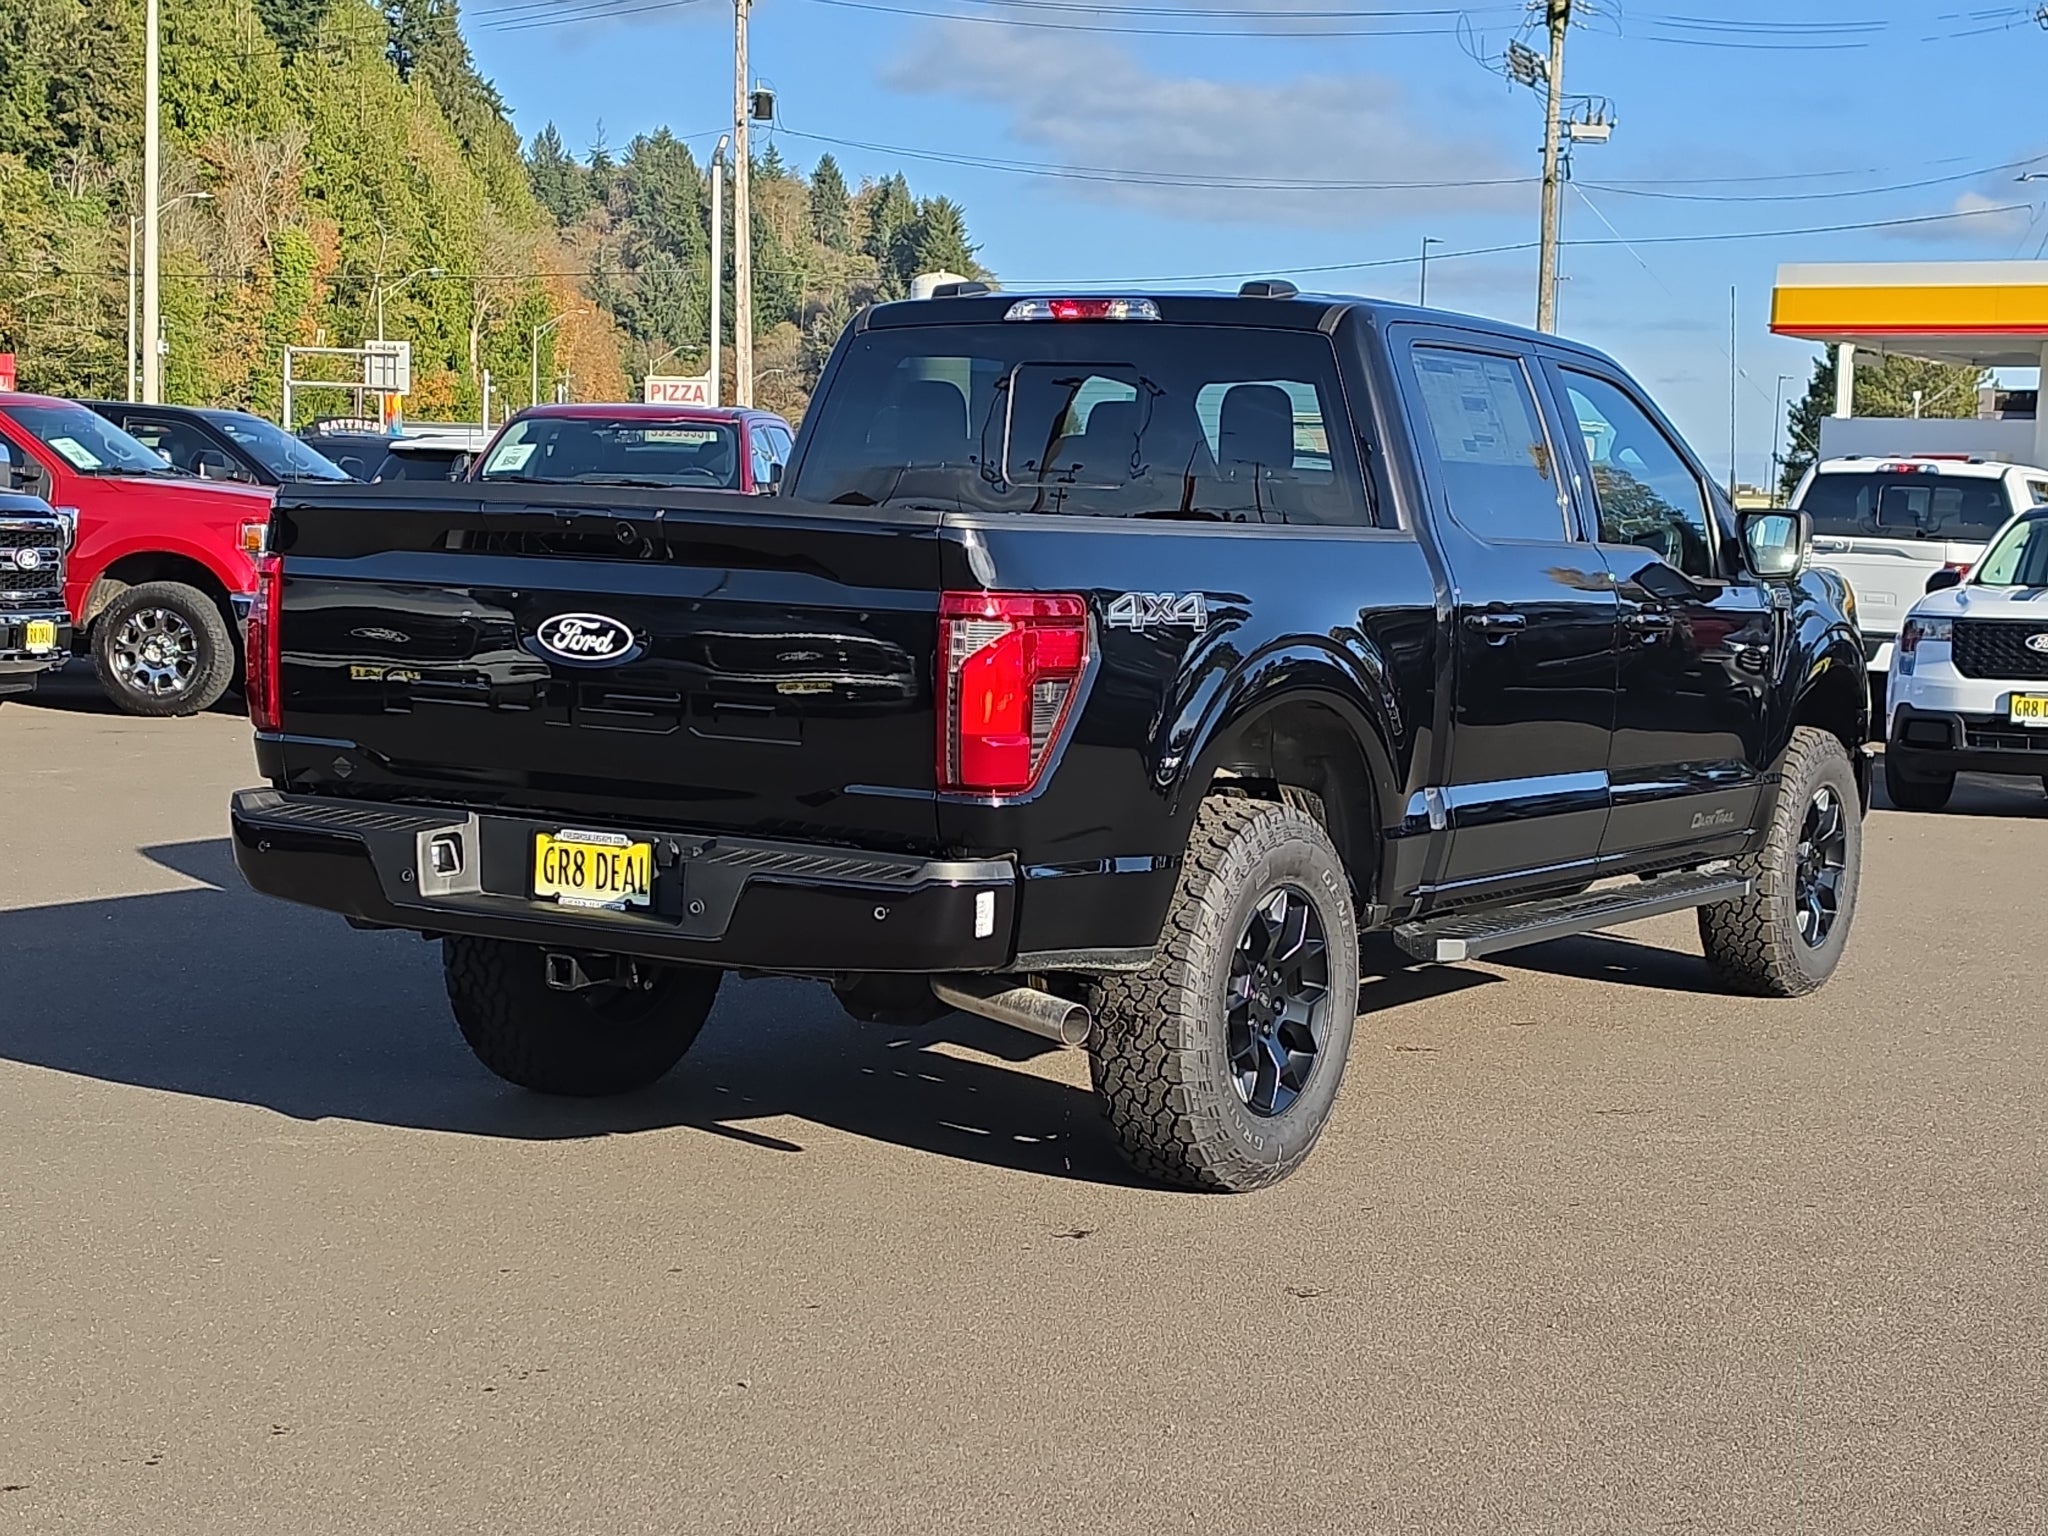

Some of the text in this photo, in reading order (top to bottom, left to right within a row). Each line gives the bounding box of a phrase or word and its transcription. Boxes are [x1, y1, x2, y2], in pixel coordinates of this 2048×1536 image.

[650, 384, 705, 402] PIZZA
[318, 418, 388, 433] MATTRES
[553, 619, 616, 653] Ford
[2014, 700, 2039, 717] GR8
[543, 846, 648, 895] GR8 DEAL
